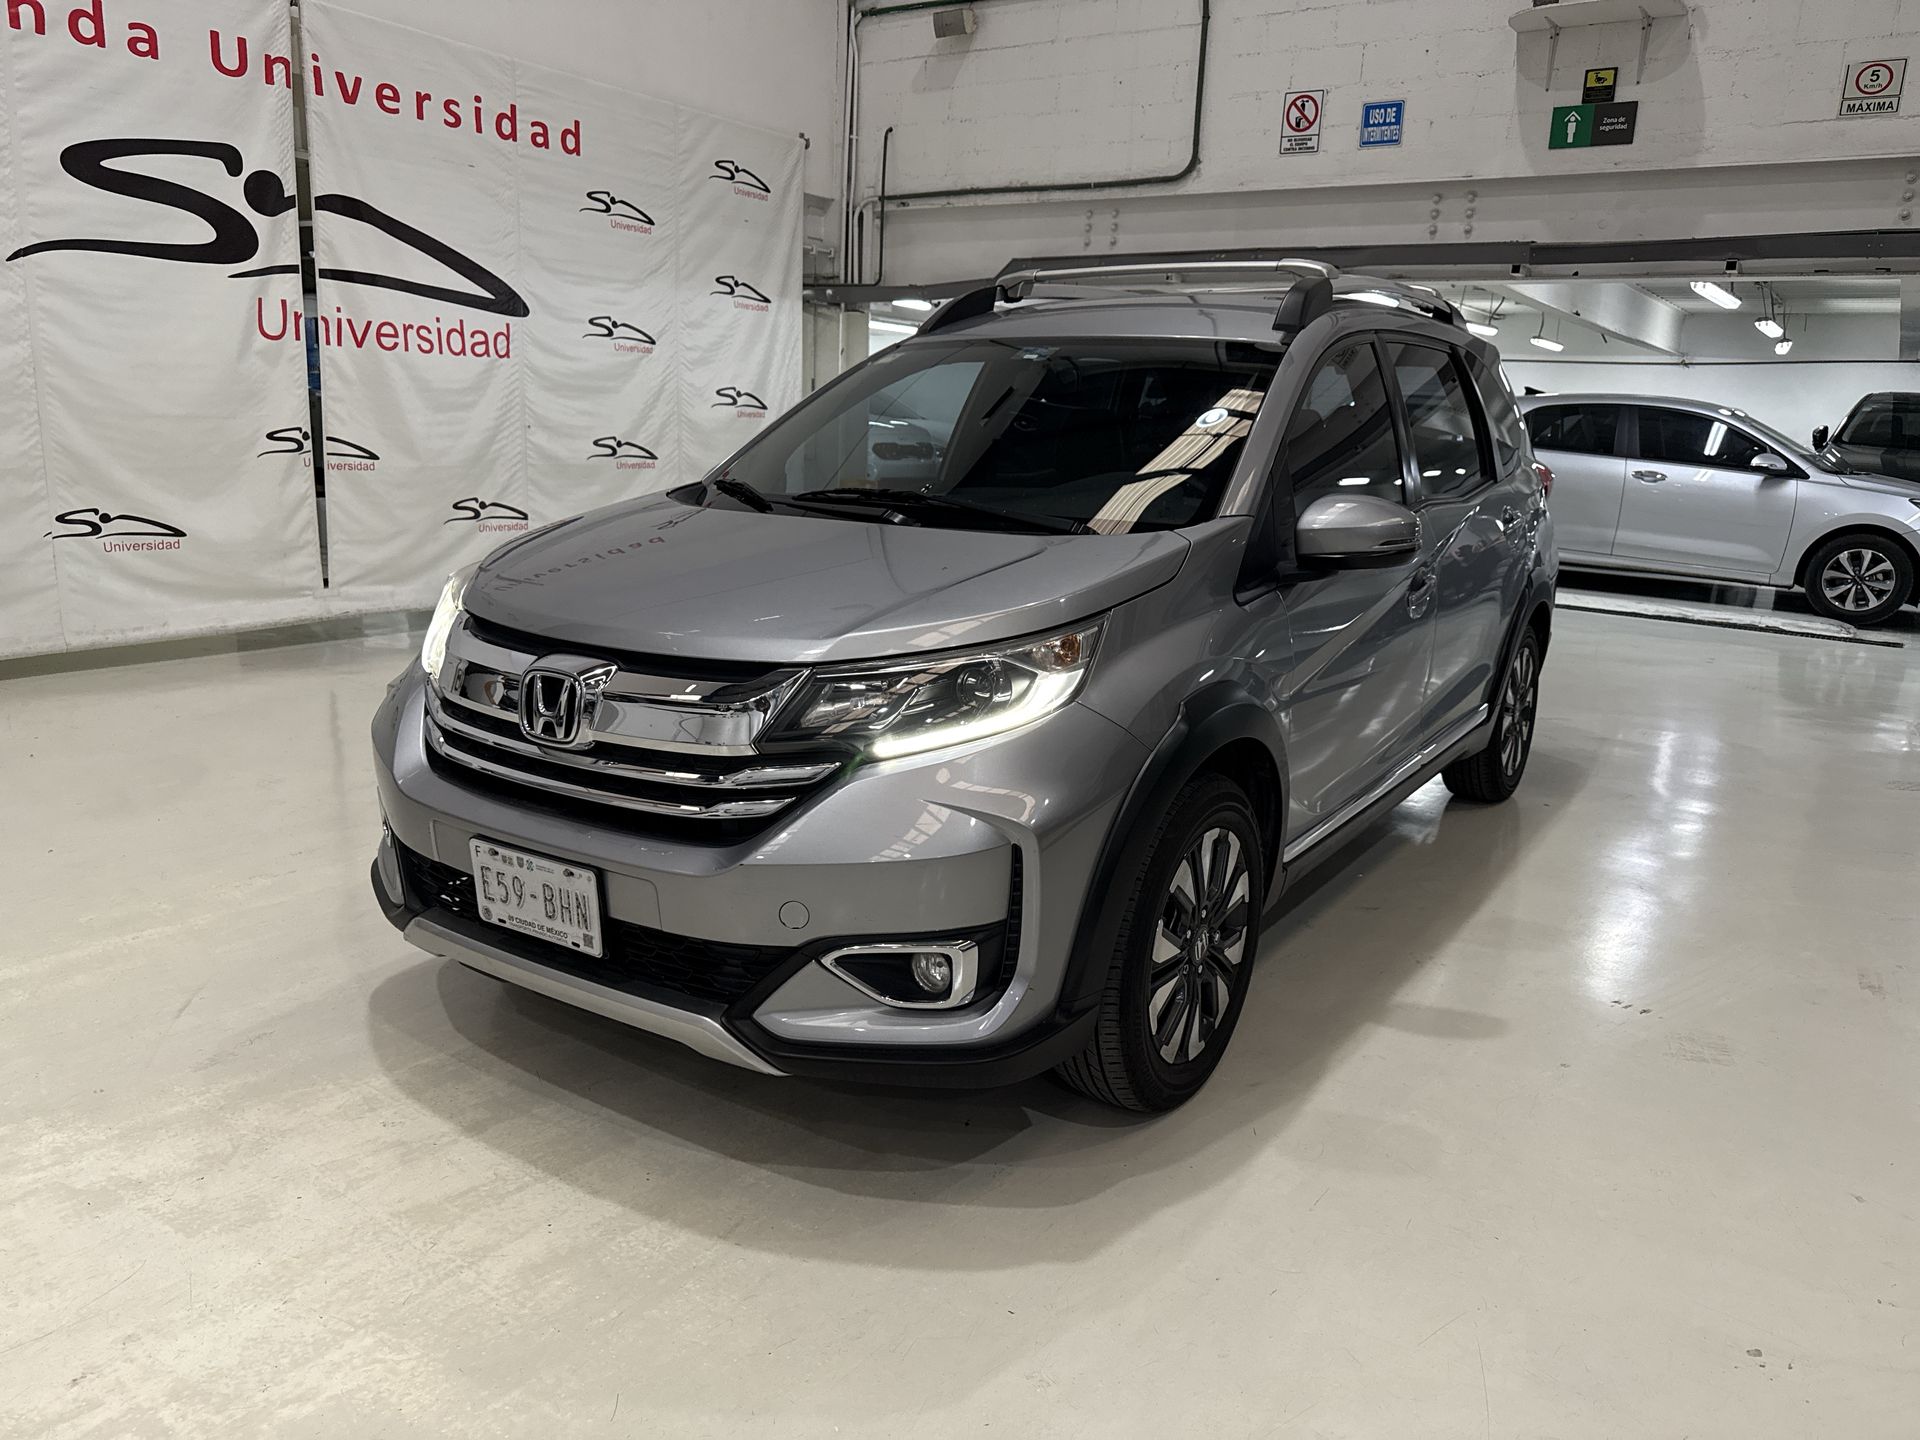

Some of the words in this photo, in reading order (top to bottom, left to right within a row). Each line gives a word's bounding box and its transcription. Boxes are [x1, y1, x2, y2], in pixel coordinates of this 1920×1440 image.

[1869, 69, 1881, 82] 5
[208, 29, 582, 157] Universidad
[1846, 100, 1894, 113] MÁXIMA
[1369, 108, 1385, 125] USO
[1386, 107, 1397, 123] DE
[1600, 123, 1628, 132] seguridad
[733, 186, 769, 202] Universidad
[610, 219, 652, 235] Universidad
[733, 300, 769, 312] Universidad
[614, 343, 653, 354] Universidad
[737, 410, 766, 419] Universidad
[303, 457, 375, 471] Uiversidad
[616, 461, 656, 470] Universidad
[478, 521, 529, 533] Universidad
[103, 539, 181, 553] Universidad
[481, 865, 591, 931] E59-BHN
[515, 916, 537, 929] CIUDAD
[537, 923, 546, 932] DE
[546, 926, 569, 939] MÉXICO
